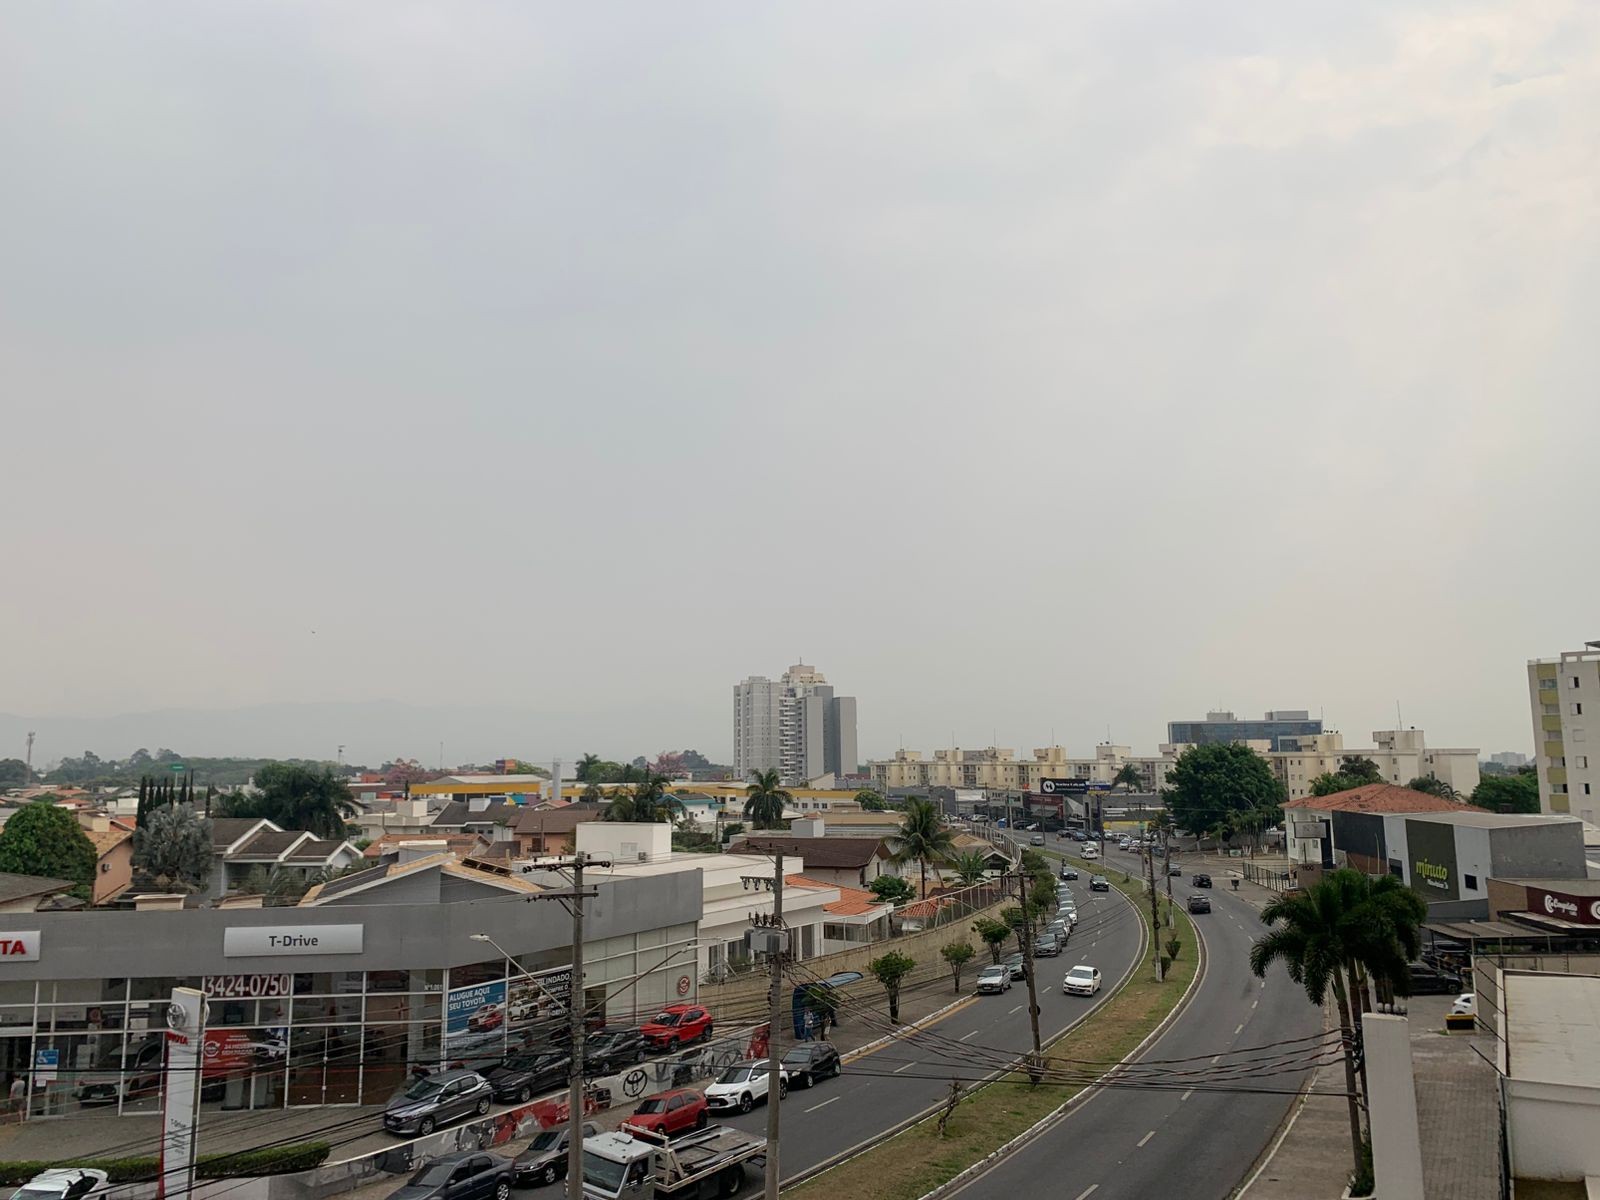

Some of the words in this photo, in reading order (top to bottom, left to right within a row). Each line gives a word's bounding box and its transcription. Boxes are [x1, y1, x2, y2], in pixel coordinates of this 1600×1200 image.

[1415, 858, 1447, 880] minuto
[0, 940, 27, 955] TA
[268, 934, 319, 947] T-Drive
[448, 990, 474, 1002] ALUGUE
[474, 986, 490, 997] AQUI
[448, 1002, 462, 1011] SEU
[462, 996, 486, 1008] TOYOTA
